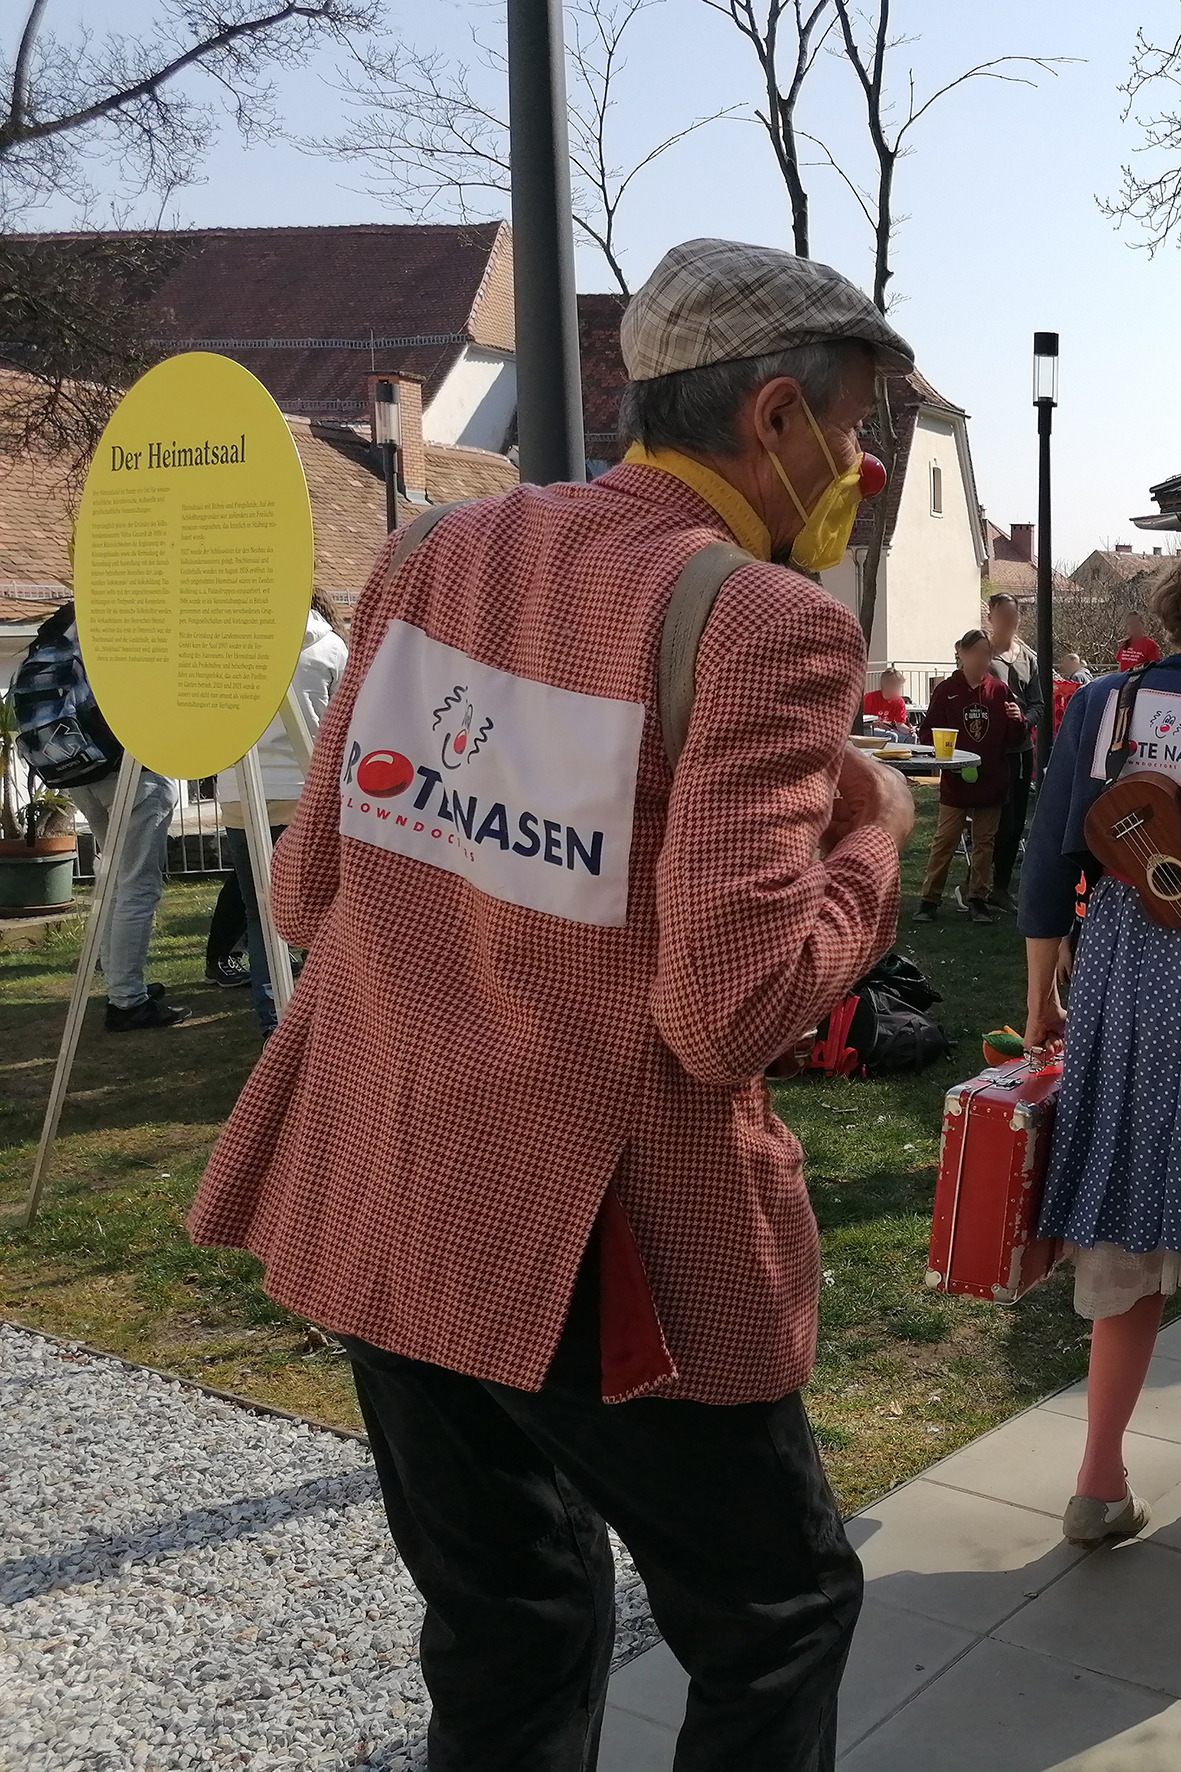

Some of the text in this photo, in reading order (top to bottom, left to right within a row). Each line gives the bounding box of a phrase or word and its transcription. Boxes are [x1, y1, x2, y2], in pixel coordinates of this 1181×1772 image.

[111, 433, 246, 472] Der Heimatsaal
[1128, 760, 1178, 770] WNDOCTORS
[452, 789, 605, 876] NASEN
